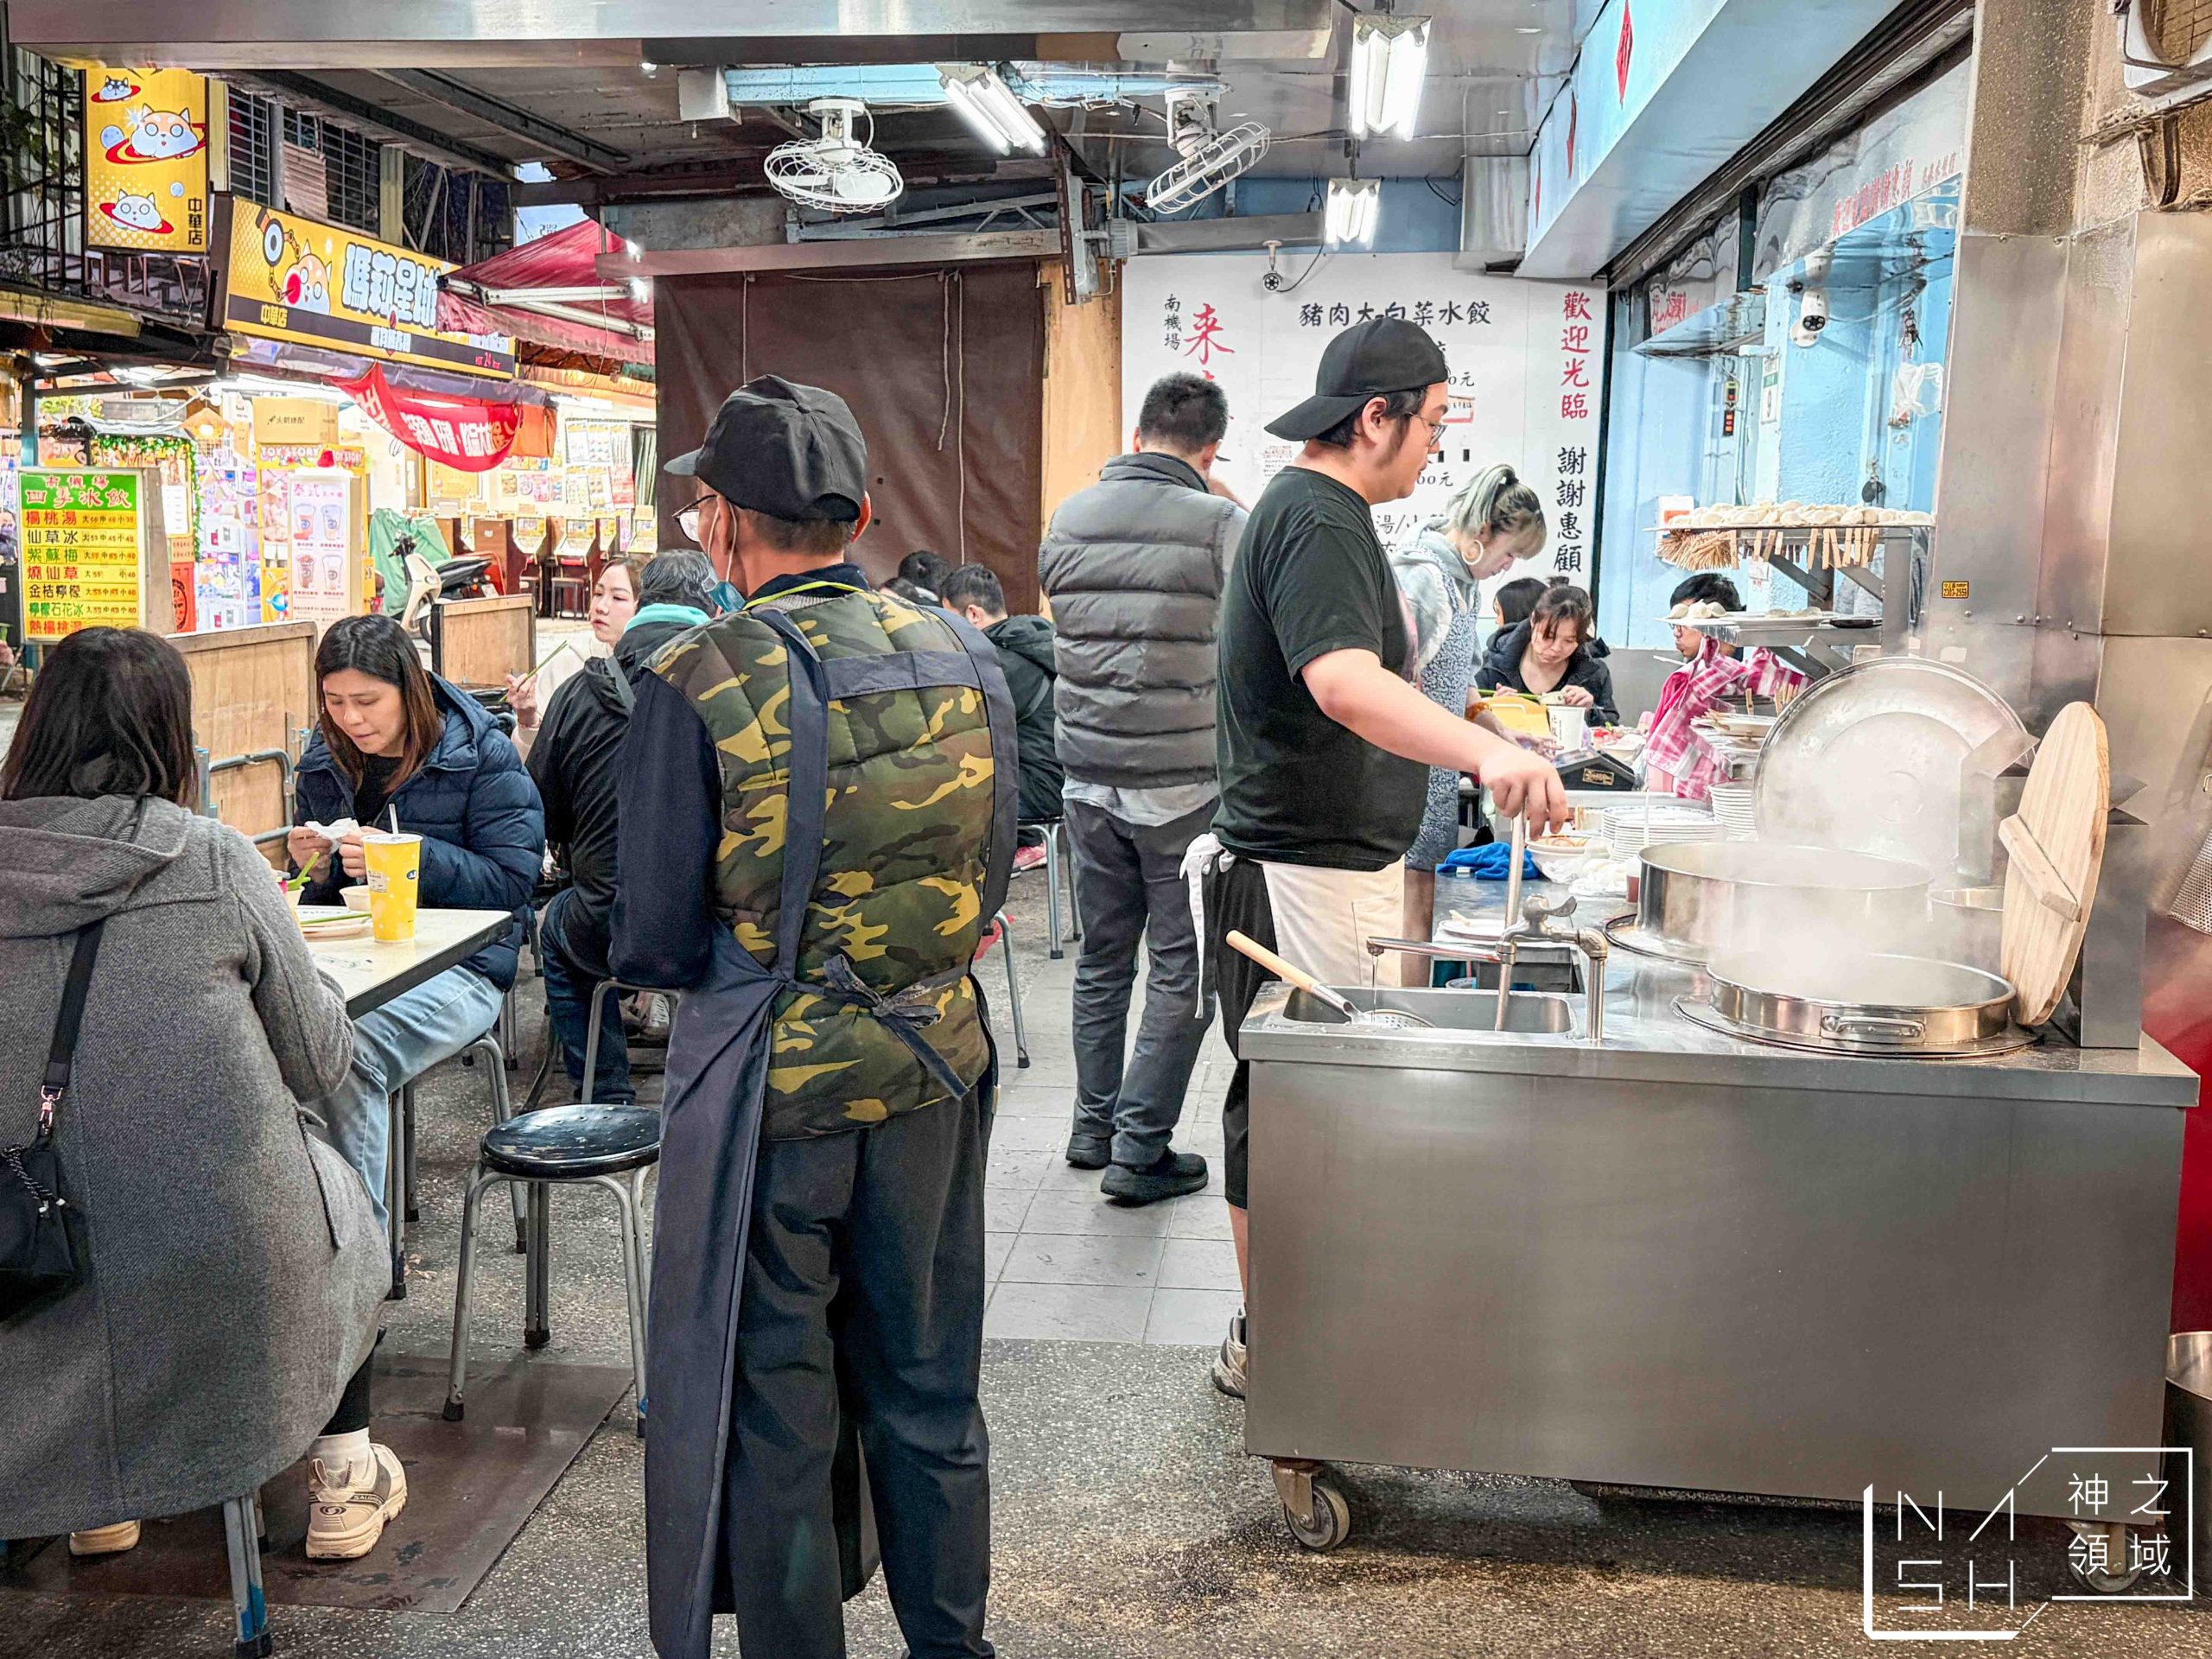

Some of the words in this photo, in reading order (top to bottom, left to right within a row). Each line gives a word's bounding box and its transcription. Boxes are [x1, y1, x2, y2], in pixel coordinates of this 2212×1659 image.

[188, 198, 203, 245] 中華店
[260, 303, 289, 328] 中華店
[1164, 293, 1182, 351] 南機場
[1299, 301, 1493, 327] 豬肉大白菜水餃
[1184, 302, 1236, 382] 來
[1560, 291, 1592, 420] 歡迎光臨
[1554, 446, 1587, 573] 謝謝惠顧
[28, 530, 79, 544] 仙草冰
